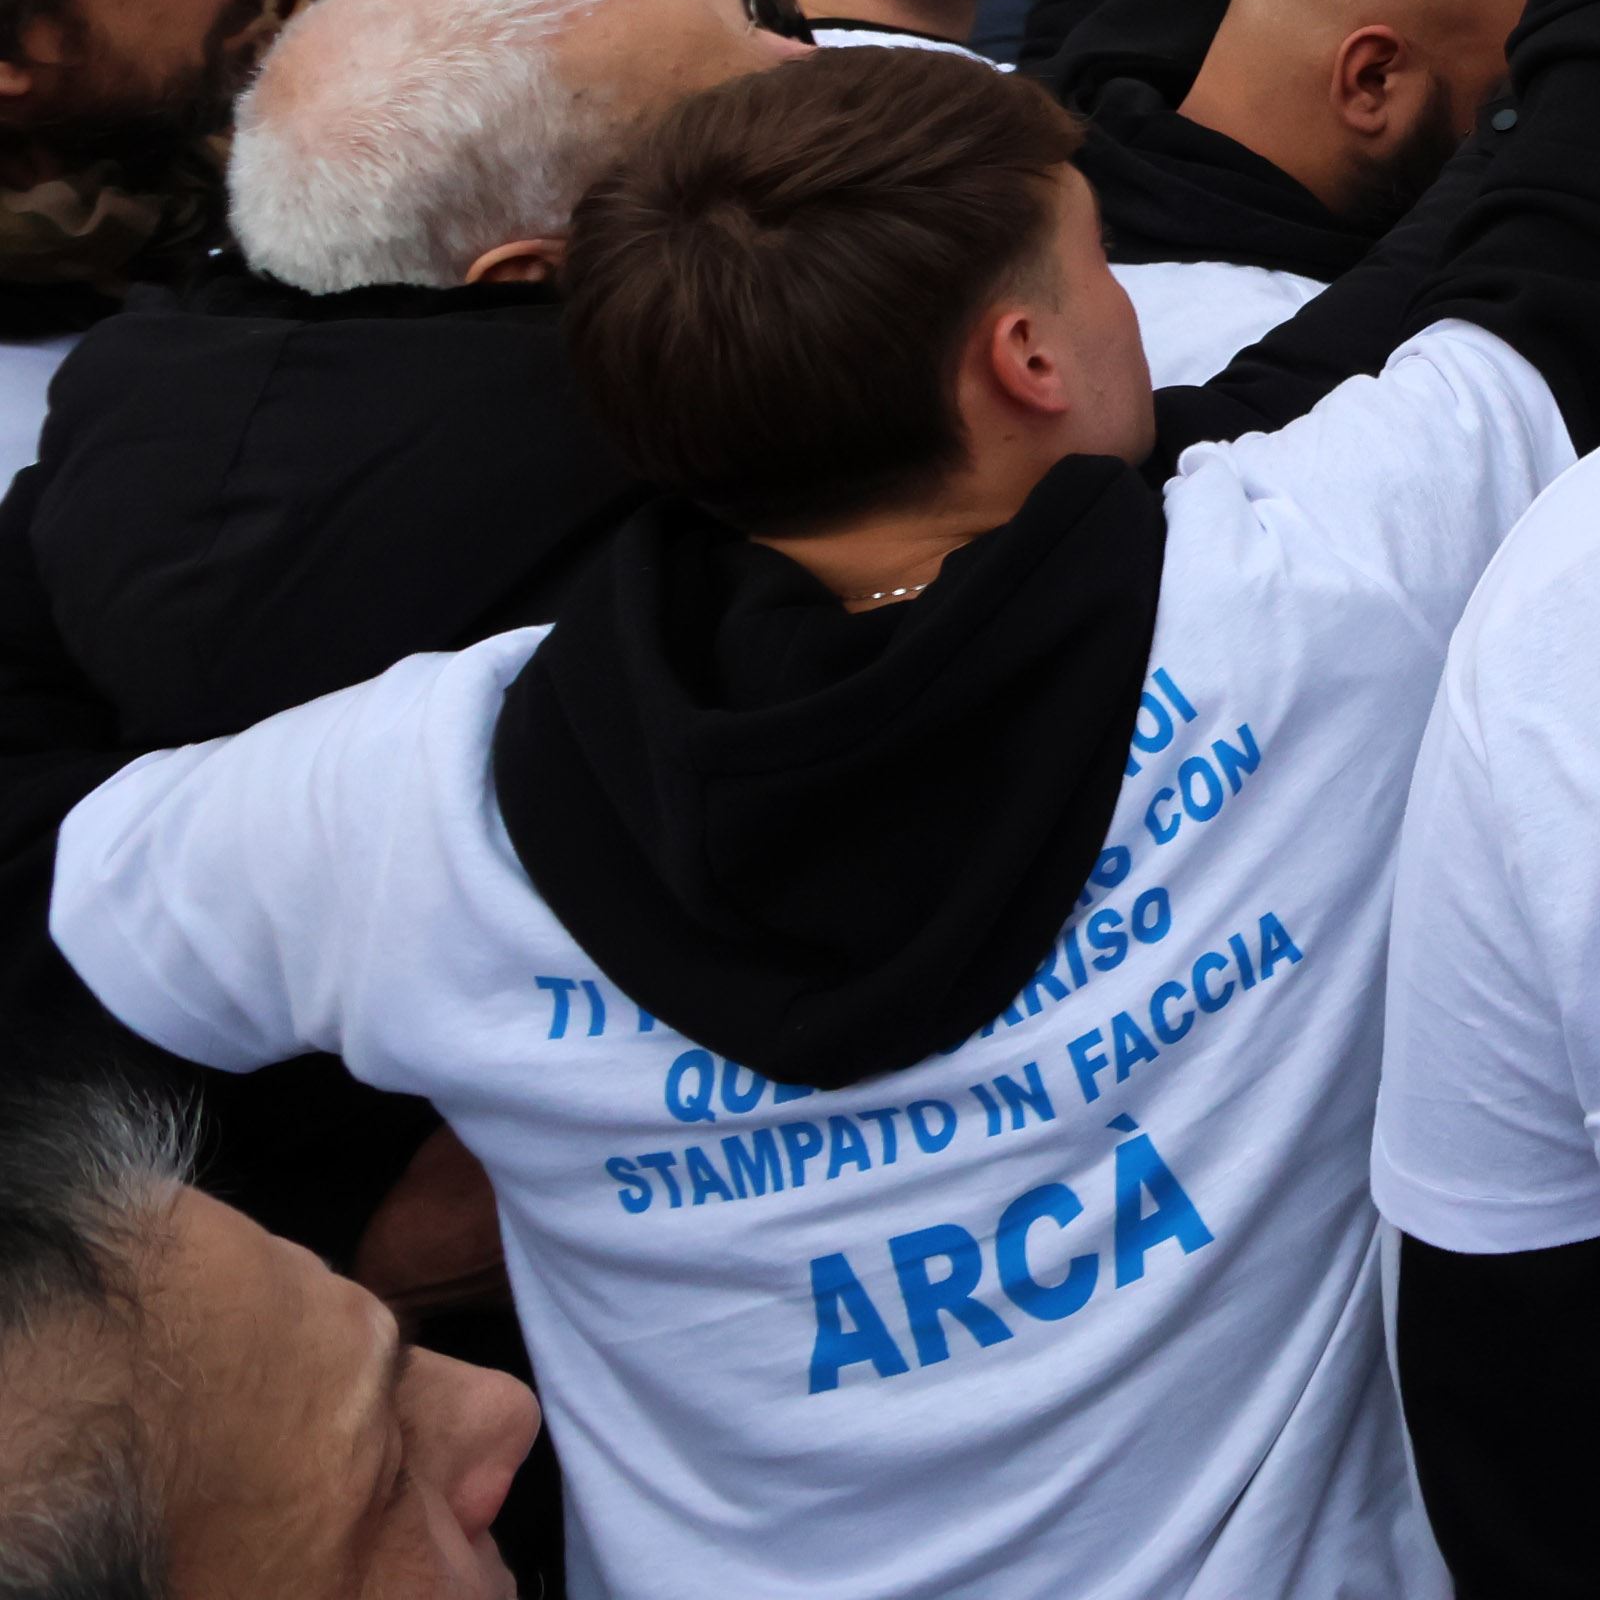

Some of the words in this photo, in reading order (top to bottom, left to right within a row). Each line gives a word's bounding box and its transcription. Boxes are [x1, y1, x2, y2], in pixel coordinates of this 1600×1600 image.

[1124, 666, 1199, 778] OI
[534, 975, 606, 1041] TI
[1143, 722, 1262, 846] CON
[605, 1099, 958, 1215] STAMPATO
[968, 1061, 1056, 1138] IN
[1066, 911, 1304, 1104] FACCIA
[808, 1111, 1215, 1395] ARCÀ
